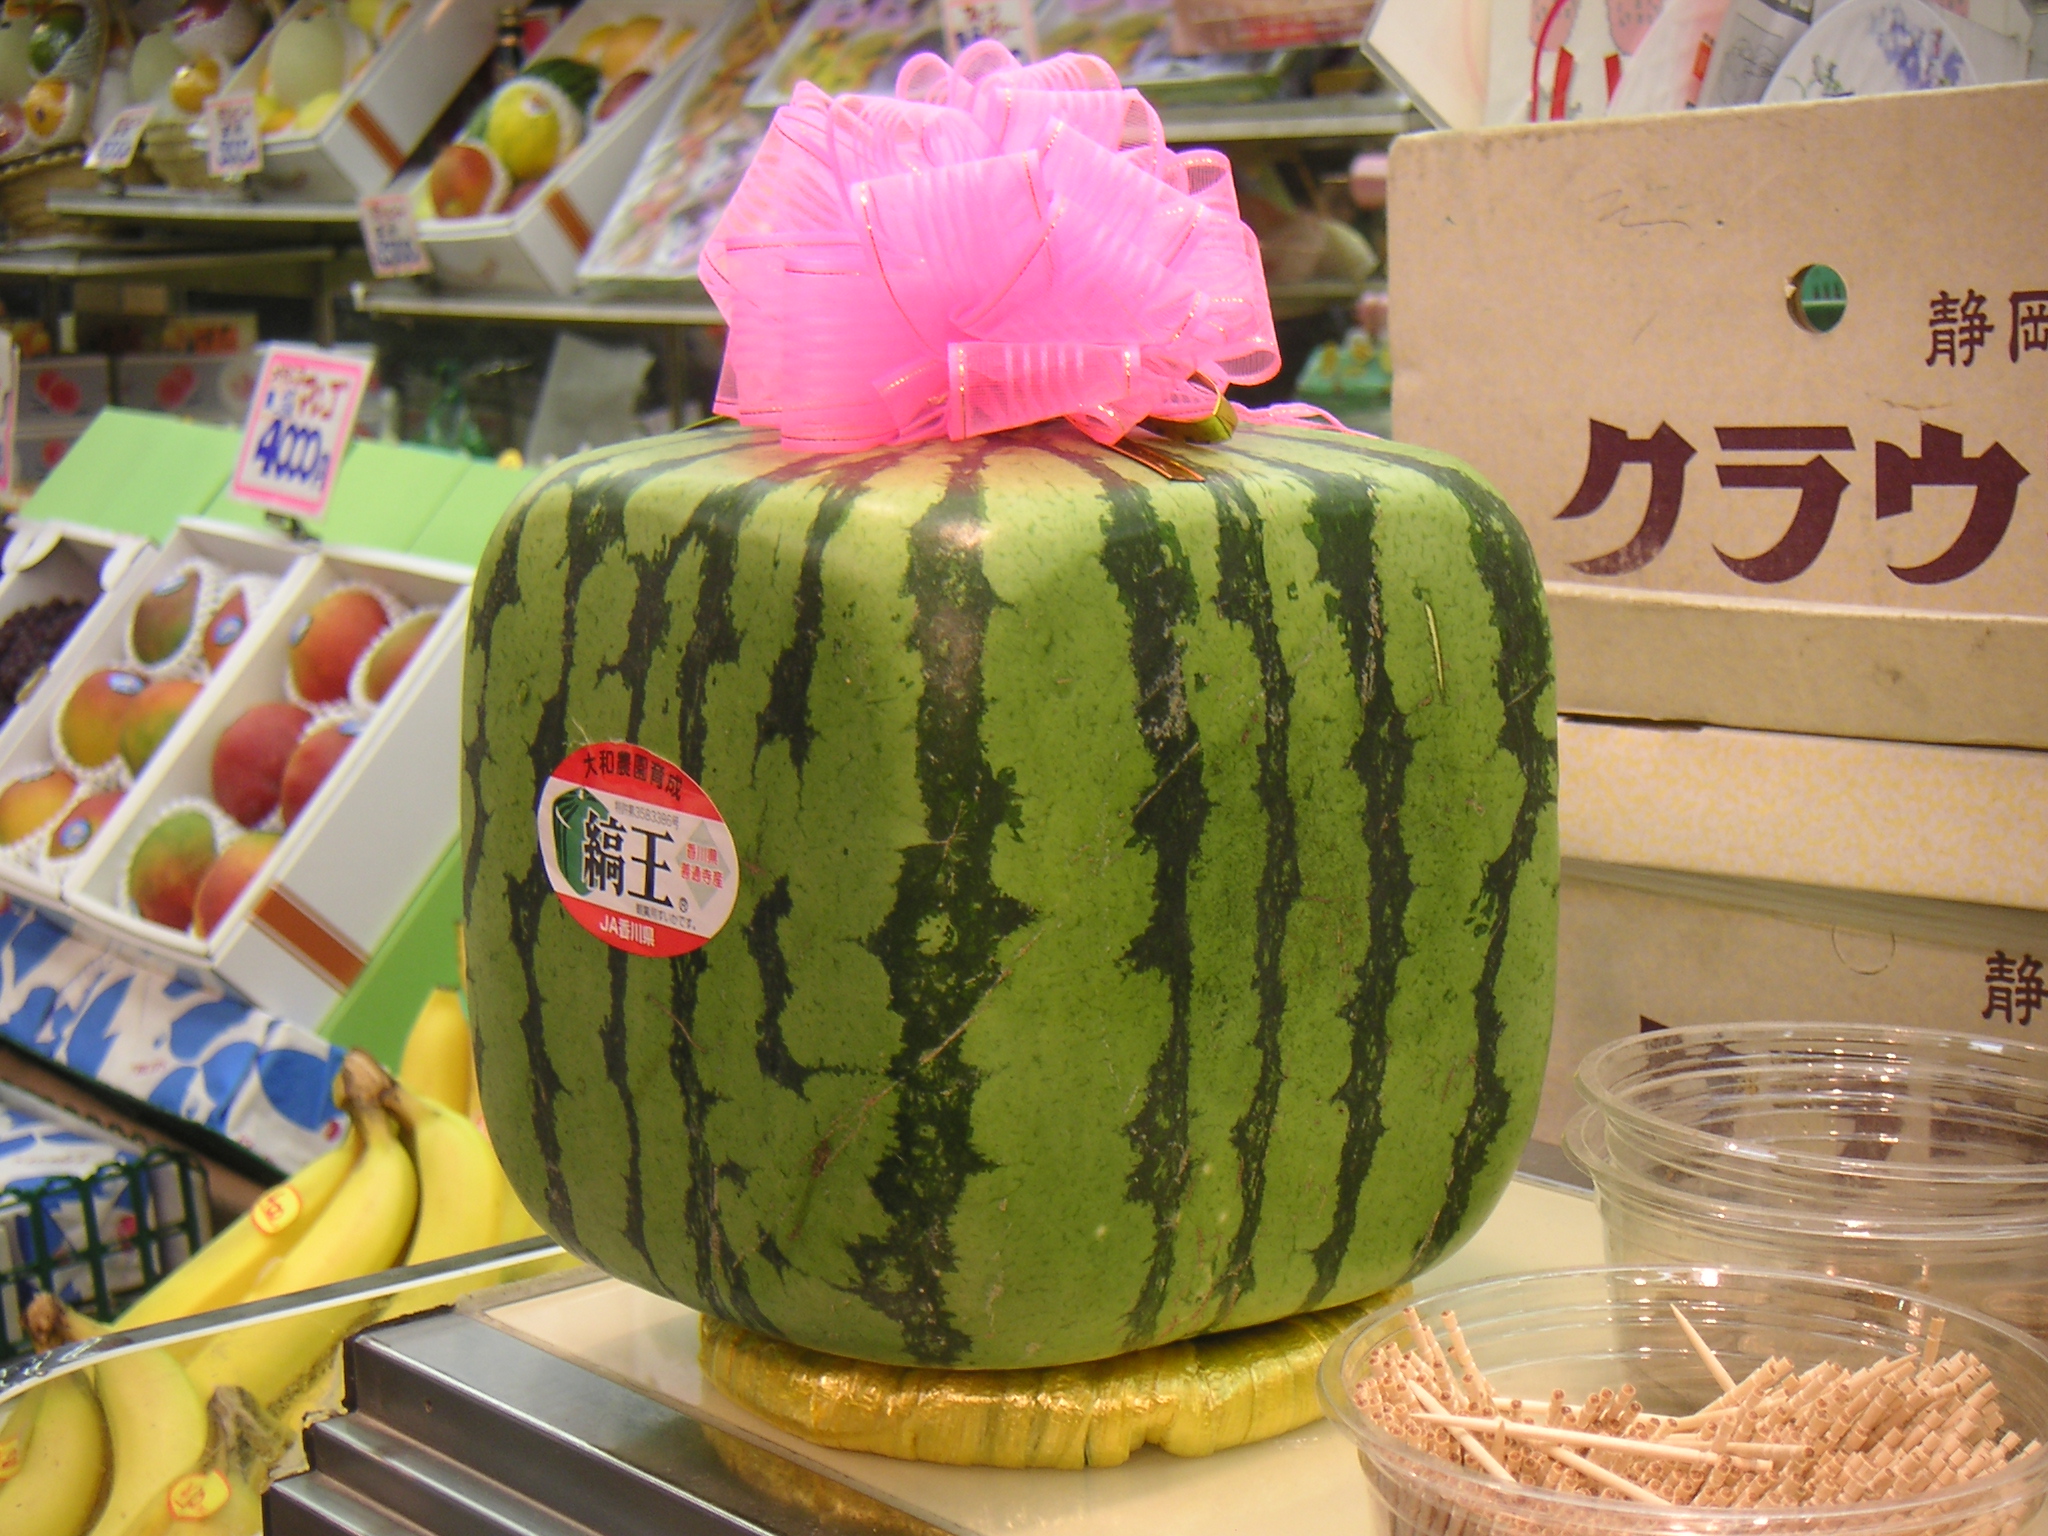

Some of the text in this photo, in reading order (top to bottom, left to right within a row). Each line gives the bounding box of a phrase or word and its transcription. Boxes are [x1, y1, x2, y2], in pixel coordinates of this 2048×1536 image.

[1925, 288, 2048, 367] 静岡
[599, 914, 656, 946] JA香川県
[1981, 949, 2048, 1026] 静
